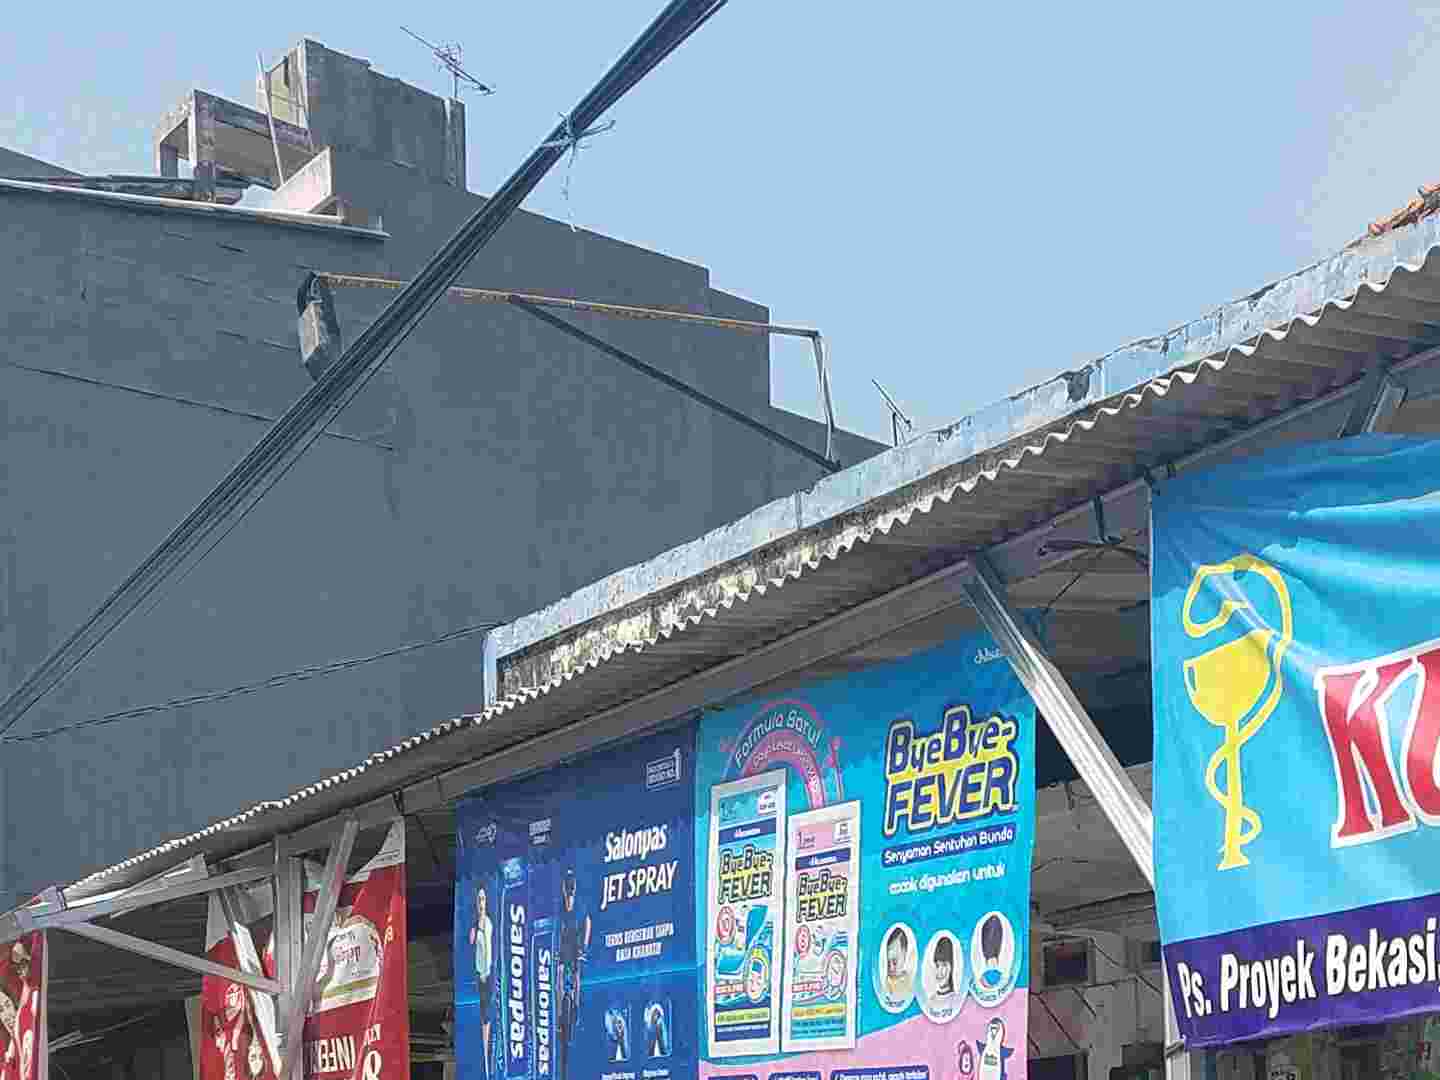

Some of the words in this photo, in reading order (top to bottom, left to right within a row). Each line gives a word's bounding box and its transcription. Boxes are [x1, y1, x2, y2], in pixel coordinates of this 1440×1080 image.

[884, 755, 1018, 837] FEVER
[604, 824, 668, 862] Salonpas
[979, 826, 1014, 844] Bunda
[601, 873, 626, 911] JET
[626, 860, 679, 900] SPRAY
[718, 872, 773, 904] FEVER
[796, 893, 847, 923] FEVER
[509, 903, 526, 1059] Salonpas
[1177, 961, 1213, 1018] Ps.
[1221, 940, 1317, 1019] Proyek
[538, 947, 551, 1075] Salonpas
